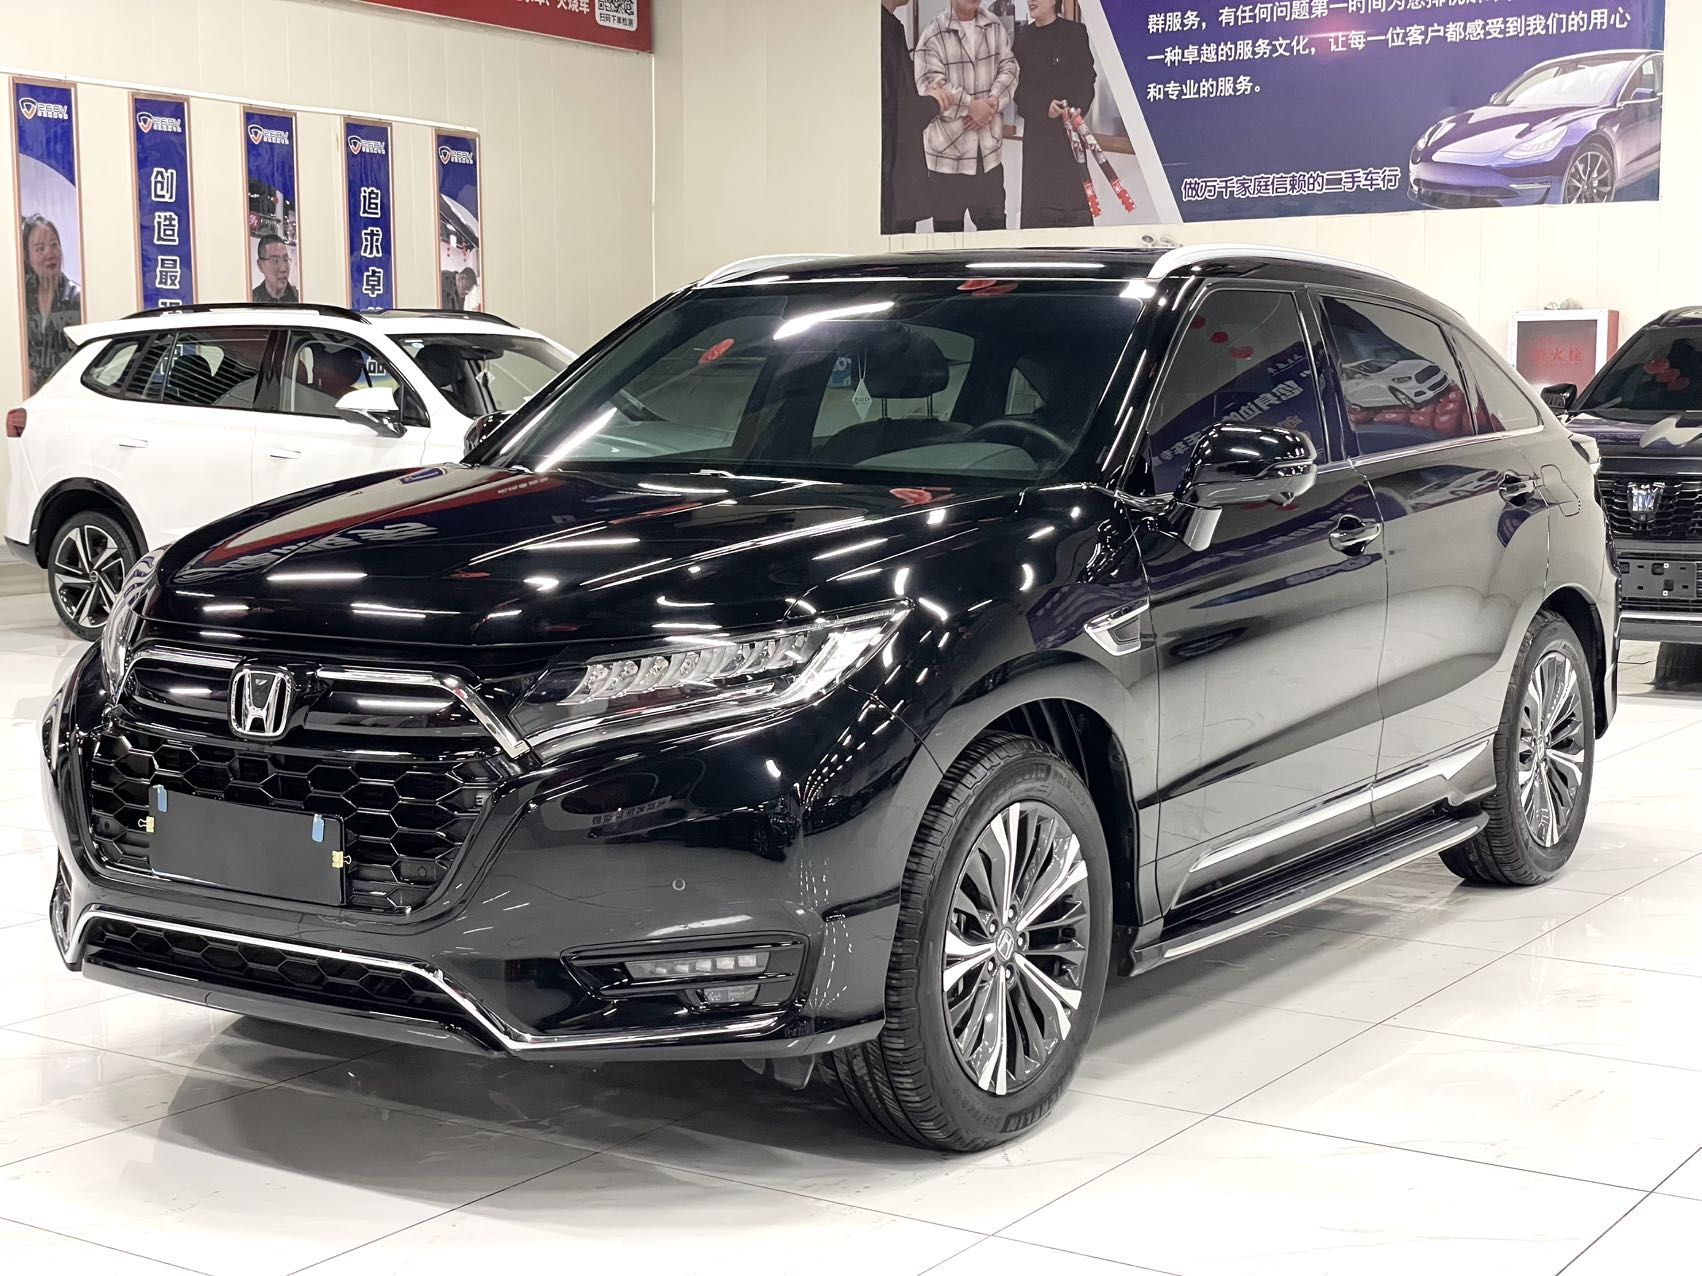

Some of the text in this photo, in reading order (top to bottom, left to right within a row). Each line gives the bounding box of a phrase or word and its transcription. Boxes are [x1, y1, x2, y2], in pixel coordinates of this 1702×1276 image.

[1147, 6, 1631, 67] 一种卓越的服务文化，让每一位客户都感受到我们的用心
[1147, 75, 1262, 102] 和专业的服务。
[1182, 167, 1400, 201] 做万千家庭信赖的二手车行
